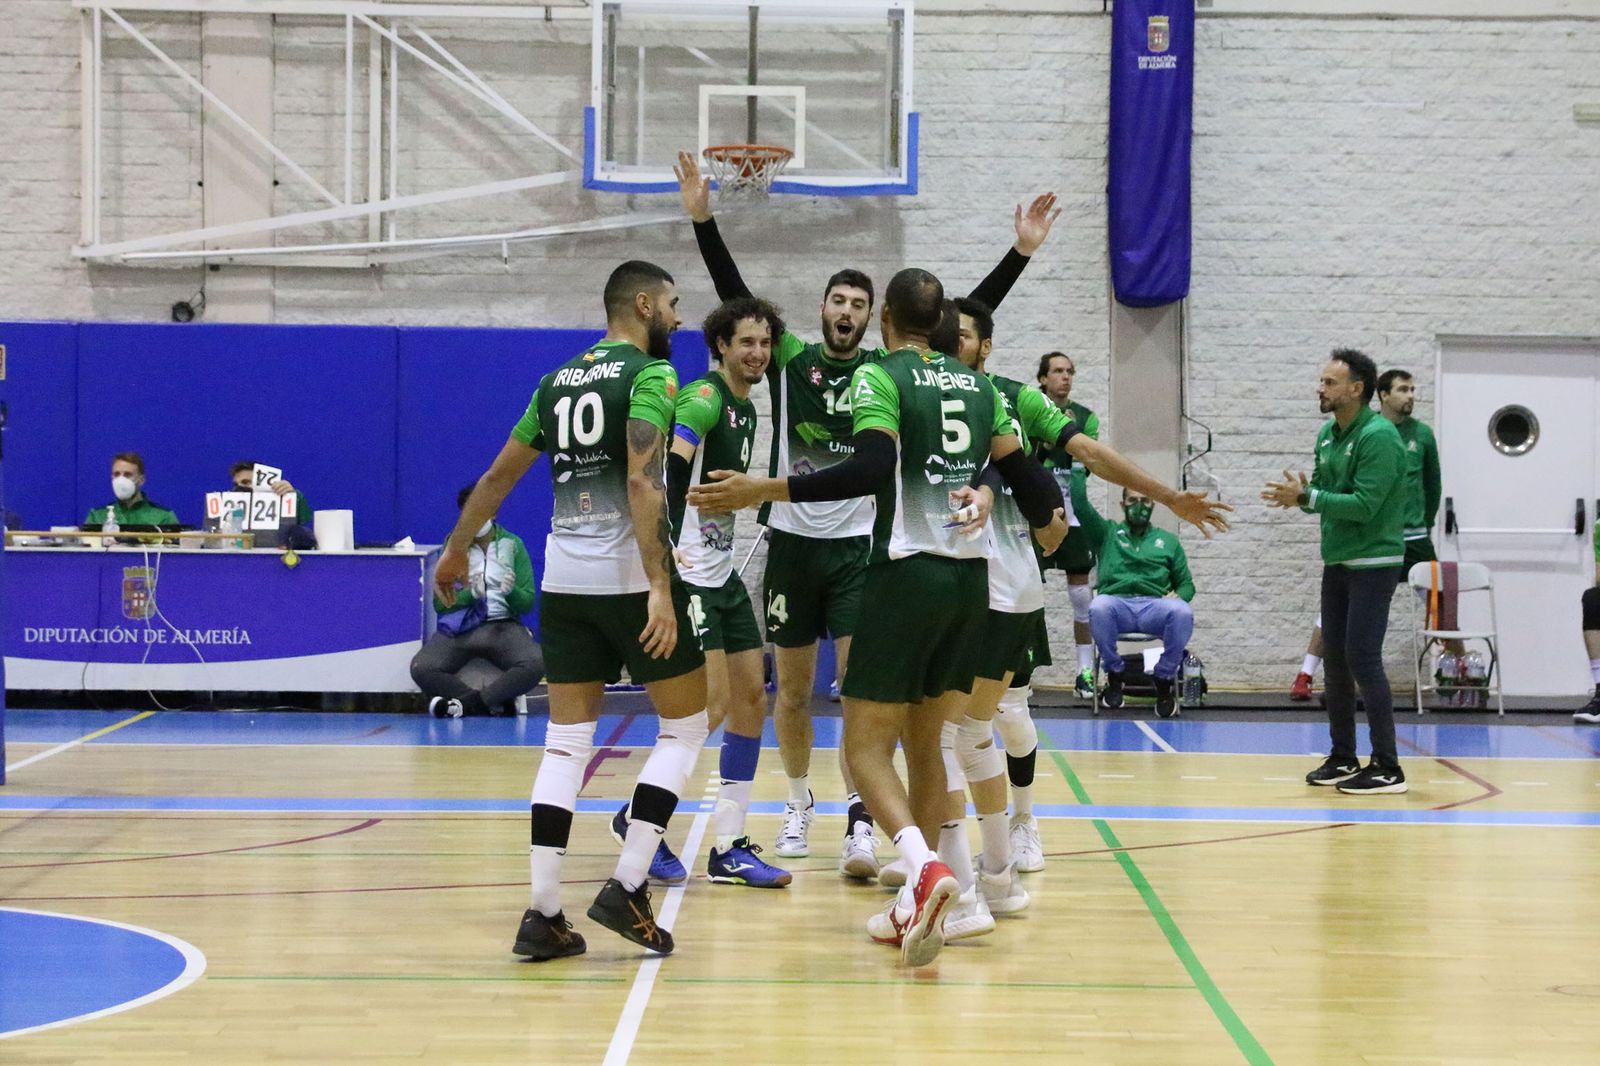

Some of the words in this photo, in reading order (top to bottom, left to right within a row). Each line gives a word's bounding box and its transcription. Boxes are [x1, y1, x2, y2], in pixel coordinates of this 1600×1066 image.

[553, 361, 625, 387] IRIBARNE
[553, 391, 605, 450] 10
[941, 399, 972, 454] 5
[740, 437, 750, 467] 4
[209, 497, 220, 516] 0
[254, 499, 277, 522] 24
[285, 498, 292, 516] 1
[24, 625, 139, 644] DIPUTACIÓN
[143, 628, 167, 644] DE
[172, 626, 252, 645] ALMERÍA
